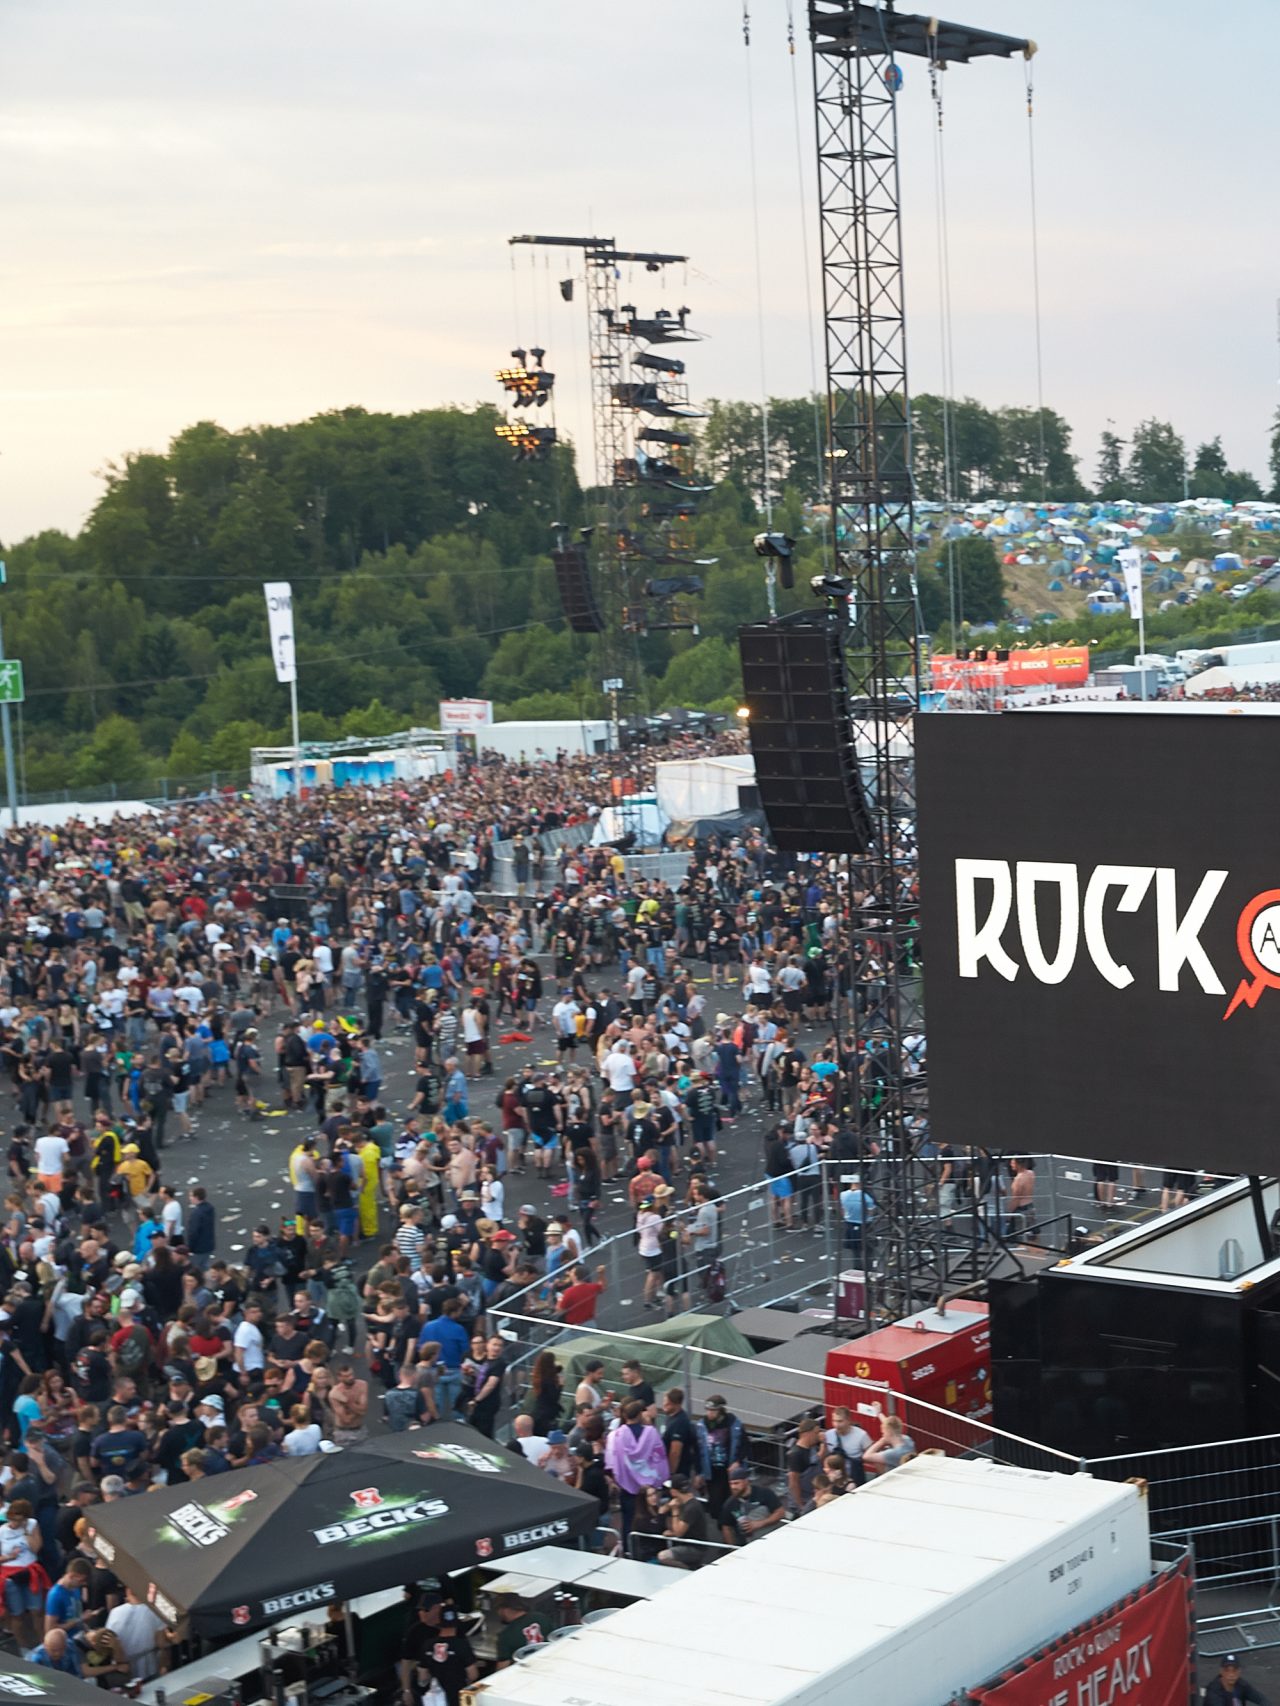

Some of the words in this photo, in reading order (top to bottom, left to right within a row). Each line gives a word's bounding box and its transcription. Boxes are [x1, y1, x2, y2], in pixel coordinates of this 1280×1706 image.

[955, 858, 1229, 995] ROCK
[168, 1502, 228, 1546] BECK'S
[313, 1499, 449, 1545] BECK'S
[504, 1520, 569, 1548] BECK'S
[263, 1583, 336, 1614] BECK'S
[1055, 1643, 1086, 1679] ROCK
[1077, 1634, 1152, 1706] HEART
